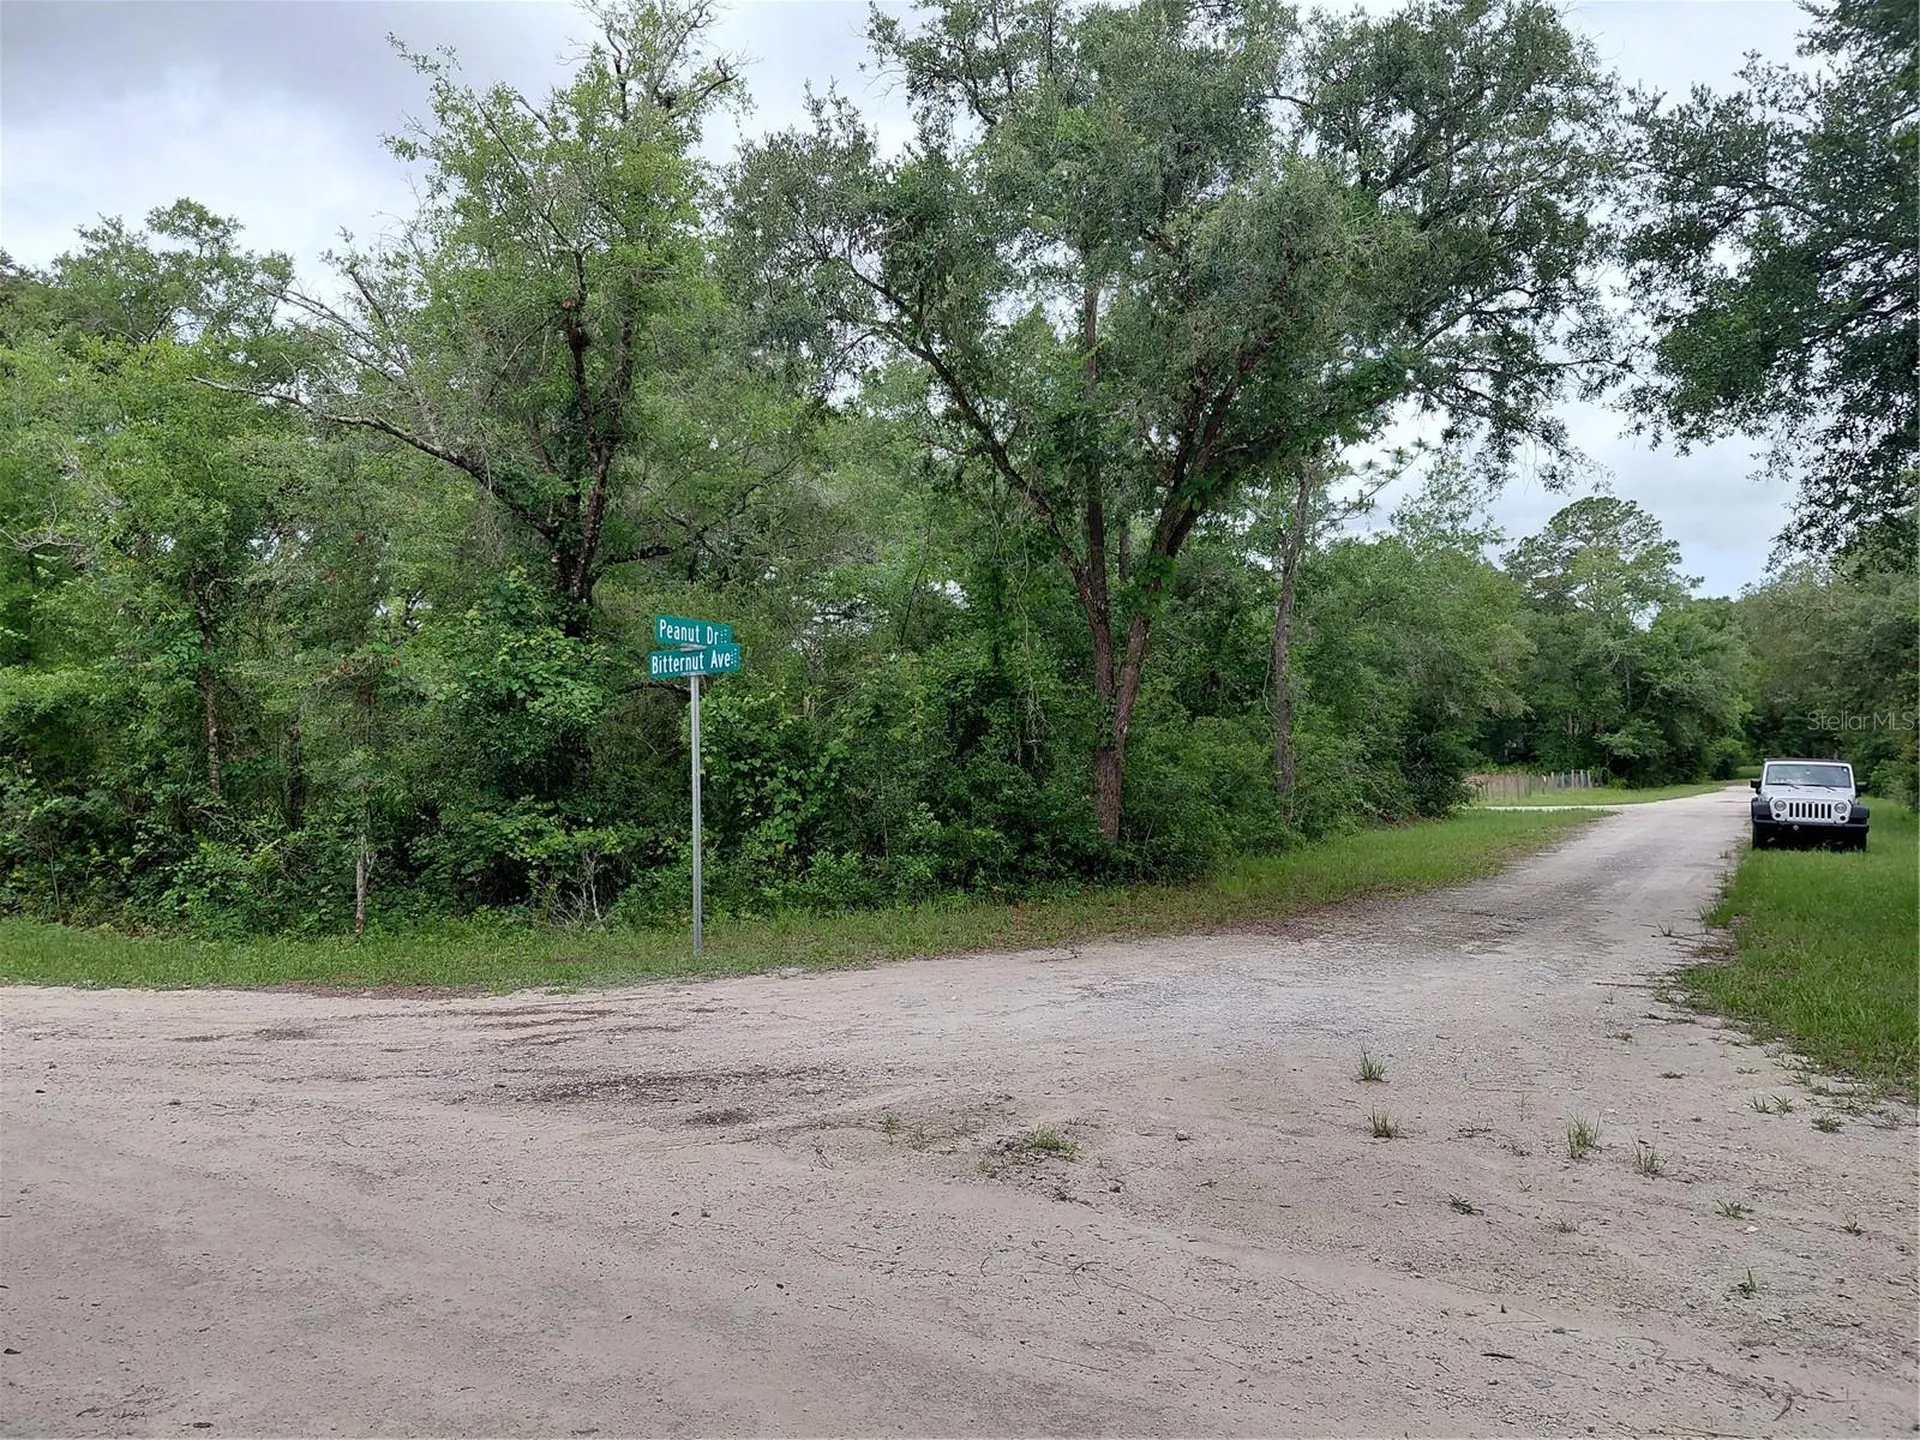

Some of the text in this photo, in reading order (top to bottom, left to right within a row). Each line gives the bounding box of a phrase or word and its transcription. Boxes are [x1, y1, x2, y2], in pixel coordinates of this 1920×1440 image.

[660, 619, 700, 643] Peanut
[706, 626, 719, 645] Dr
[652, 652, 704, 674] Bitternut
[710, 650, 730, 668] Ave
